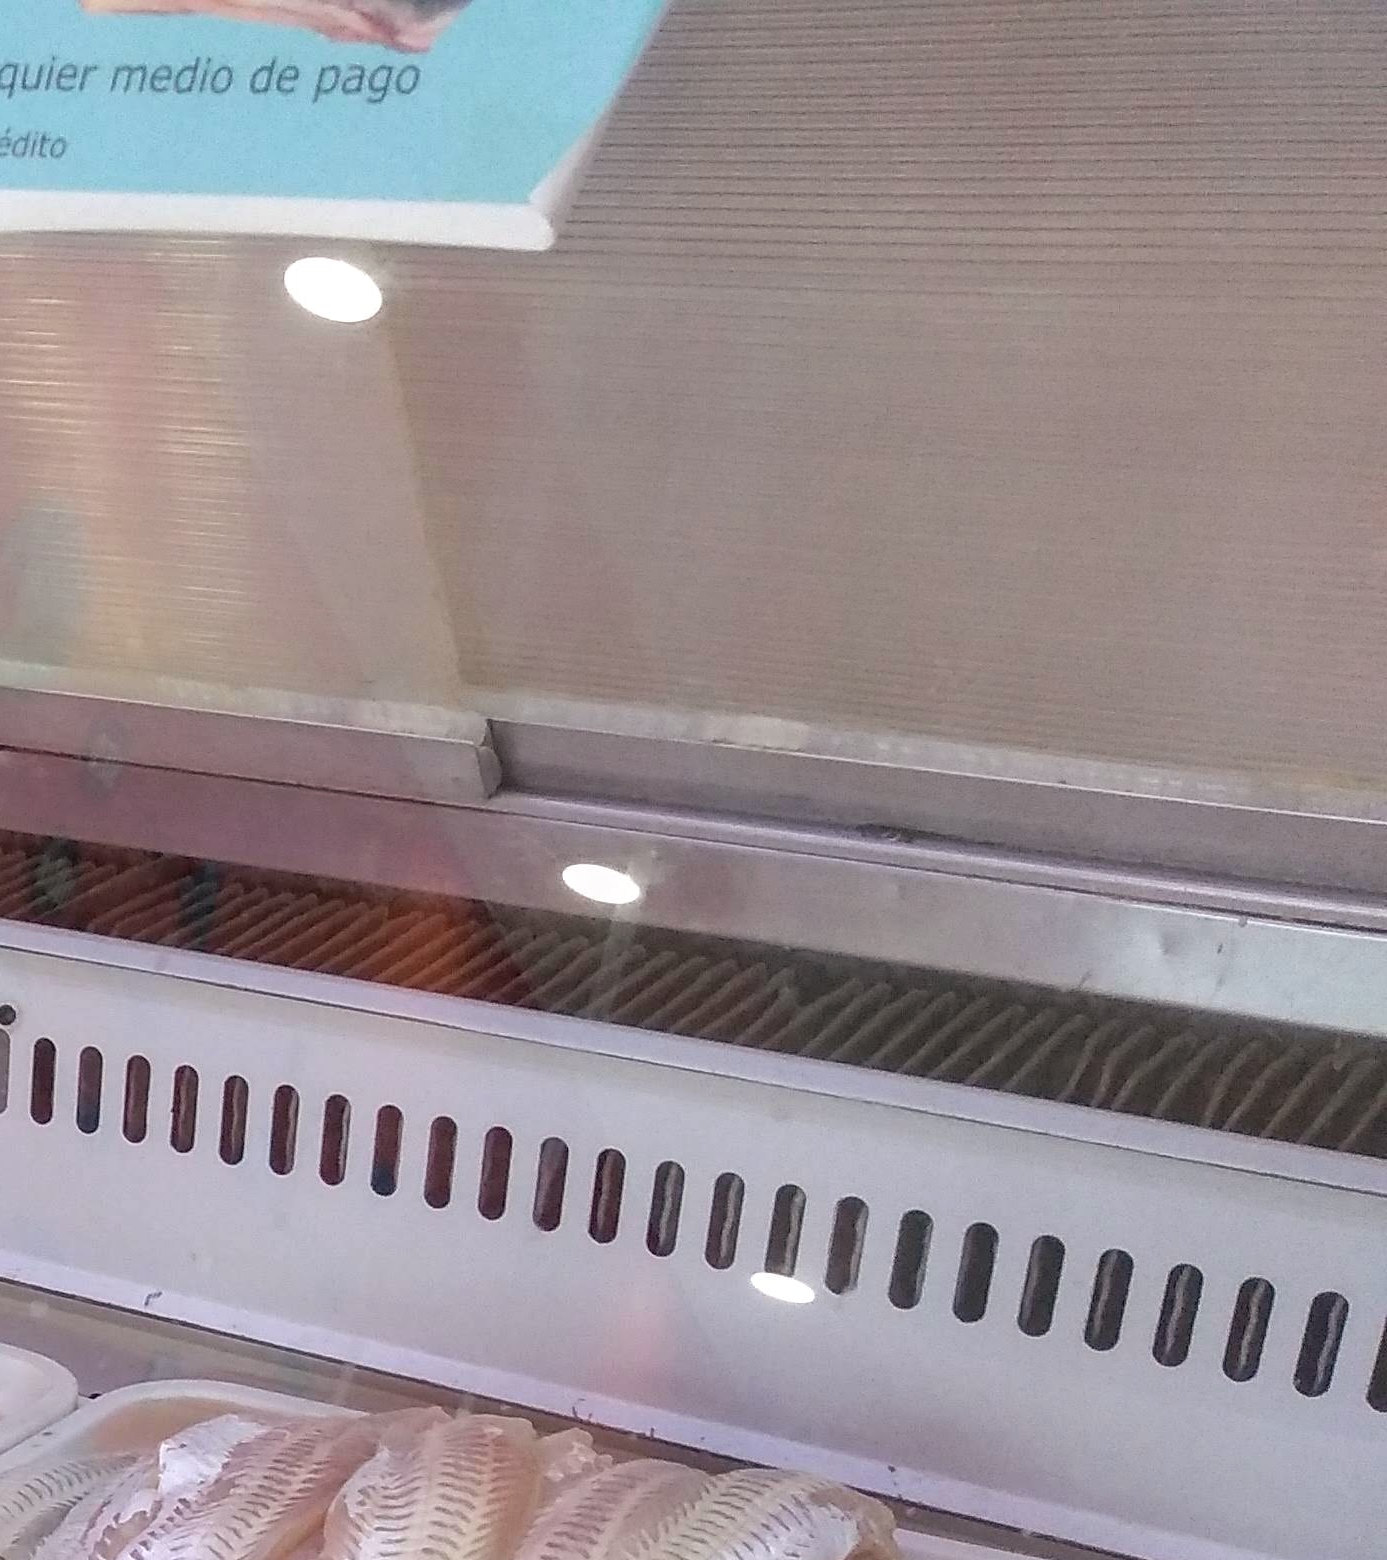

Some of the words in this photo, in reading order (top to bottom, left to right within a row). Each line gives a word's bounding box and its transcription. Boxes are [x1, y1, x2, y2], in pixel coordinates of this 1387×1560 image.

[109, 56, 233, 96] medio
[249, 57, 300, 96] de
[312, 63, 422, 105] pago
